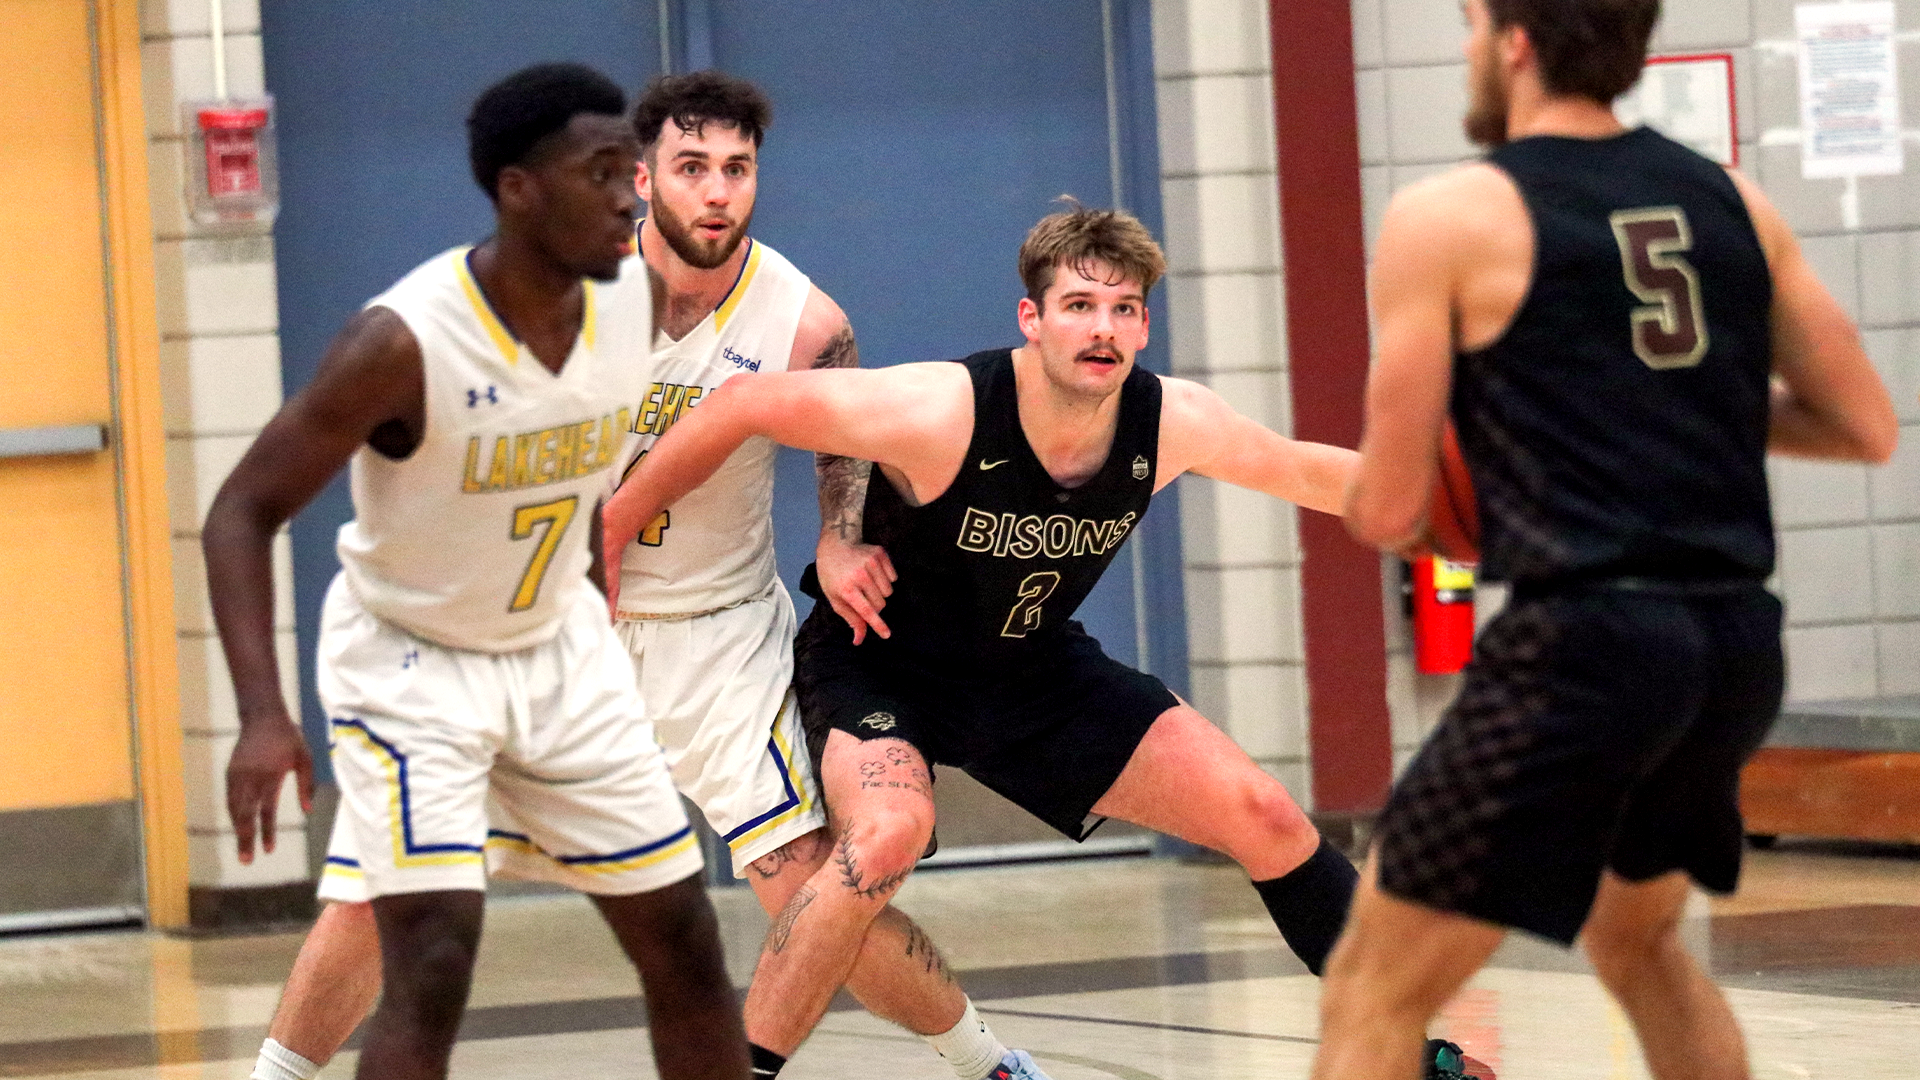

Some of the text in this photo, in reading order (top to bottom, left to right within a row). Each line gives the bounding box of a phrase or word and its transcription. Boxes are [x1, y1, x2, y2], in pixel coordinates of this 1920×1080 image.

[1608, 206, 1710, 371] 5
[722, 346, 762, 373] tbaytel
[629, 382, 717, 436] EHE
[508, 494, 579, 614] 7
[957, 506, 1136, 560] BISONS
[1000, 571, 1062, 639] 2
